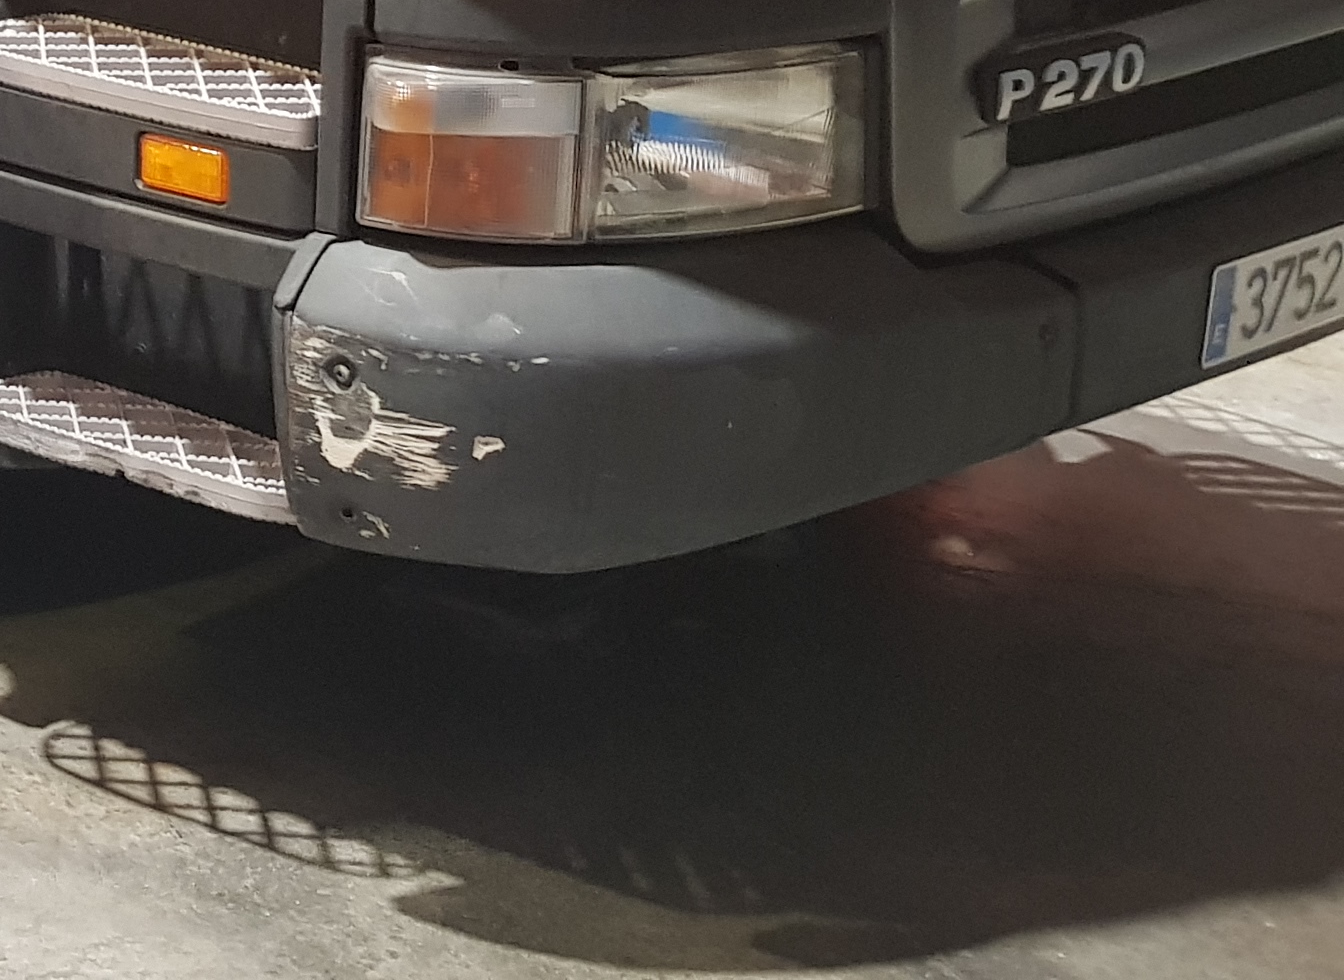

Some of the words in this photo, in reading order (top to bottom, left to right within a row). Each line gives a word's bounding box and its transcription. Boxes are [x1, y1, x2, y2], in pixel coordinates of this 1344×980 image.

[996, 69, 1035, 121] P
[1039, 43, 1146, 112] 270
[1240, 240, 1343, 340] 3752
